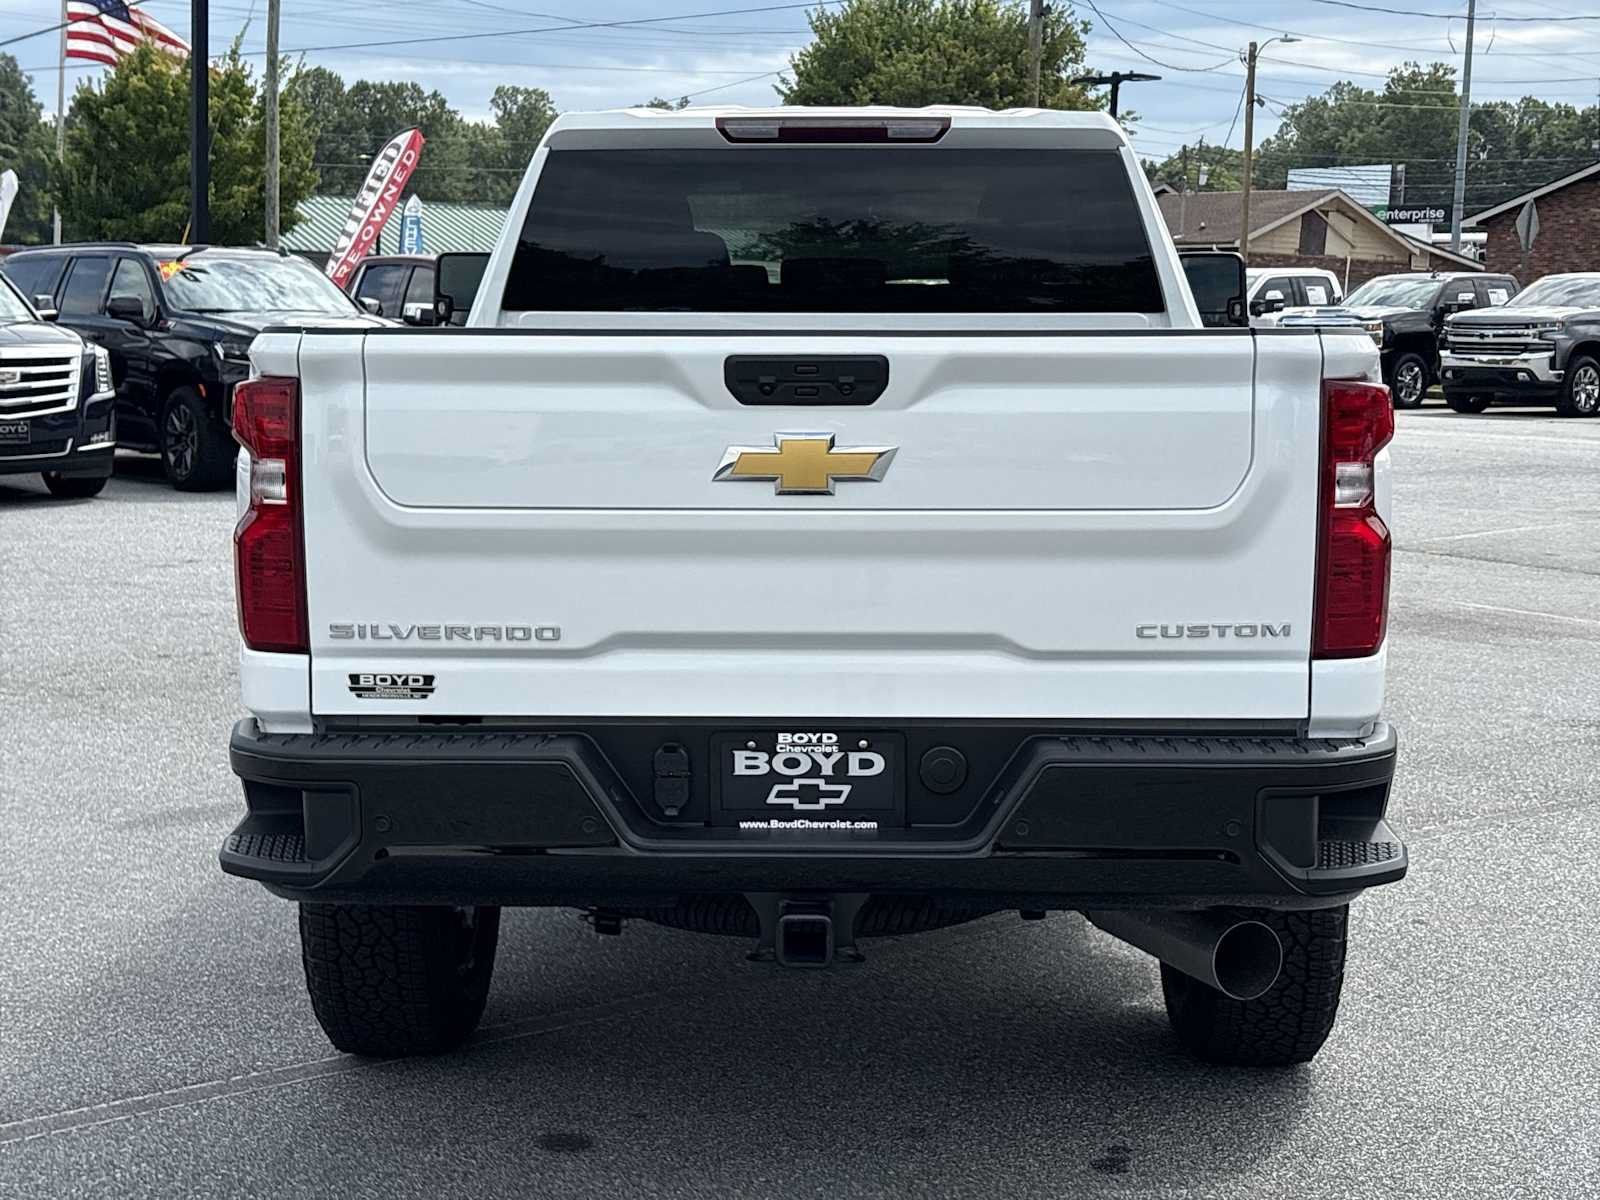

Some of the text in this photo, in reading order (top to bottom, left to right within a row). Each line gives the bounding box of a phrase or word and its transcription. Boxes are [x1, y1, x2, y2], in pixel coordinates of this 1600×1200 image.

[335, 149, 417, 279] RE-OWNED
[1376, 207, 1444, 222] enterprise
[329, 624, 561, 641] SILVERADO
[1136, 623, 1292, 638] CUSTOM
[359, 674, 424, 686] BOYD
[777, 733, 838, 743] BOYD
[776, 744, 839, 753] Chevrolet
[732, 750, 886, 776] BOYD
